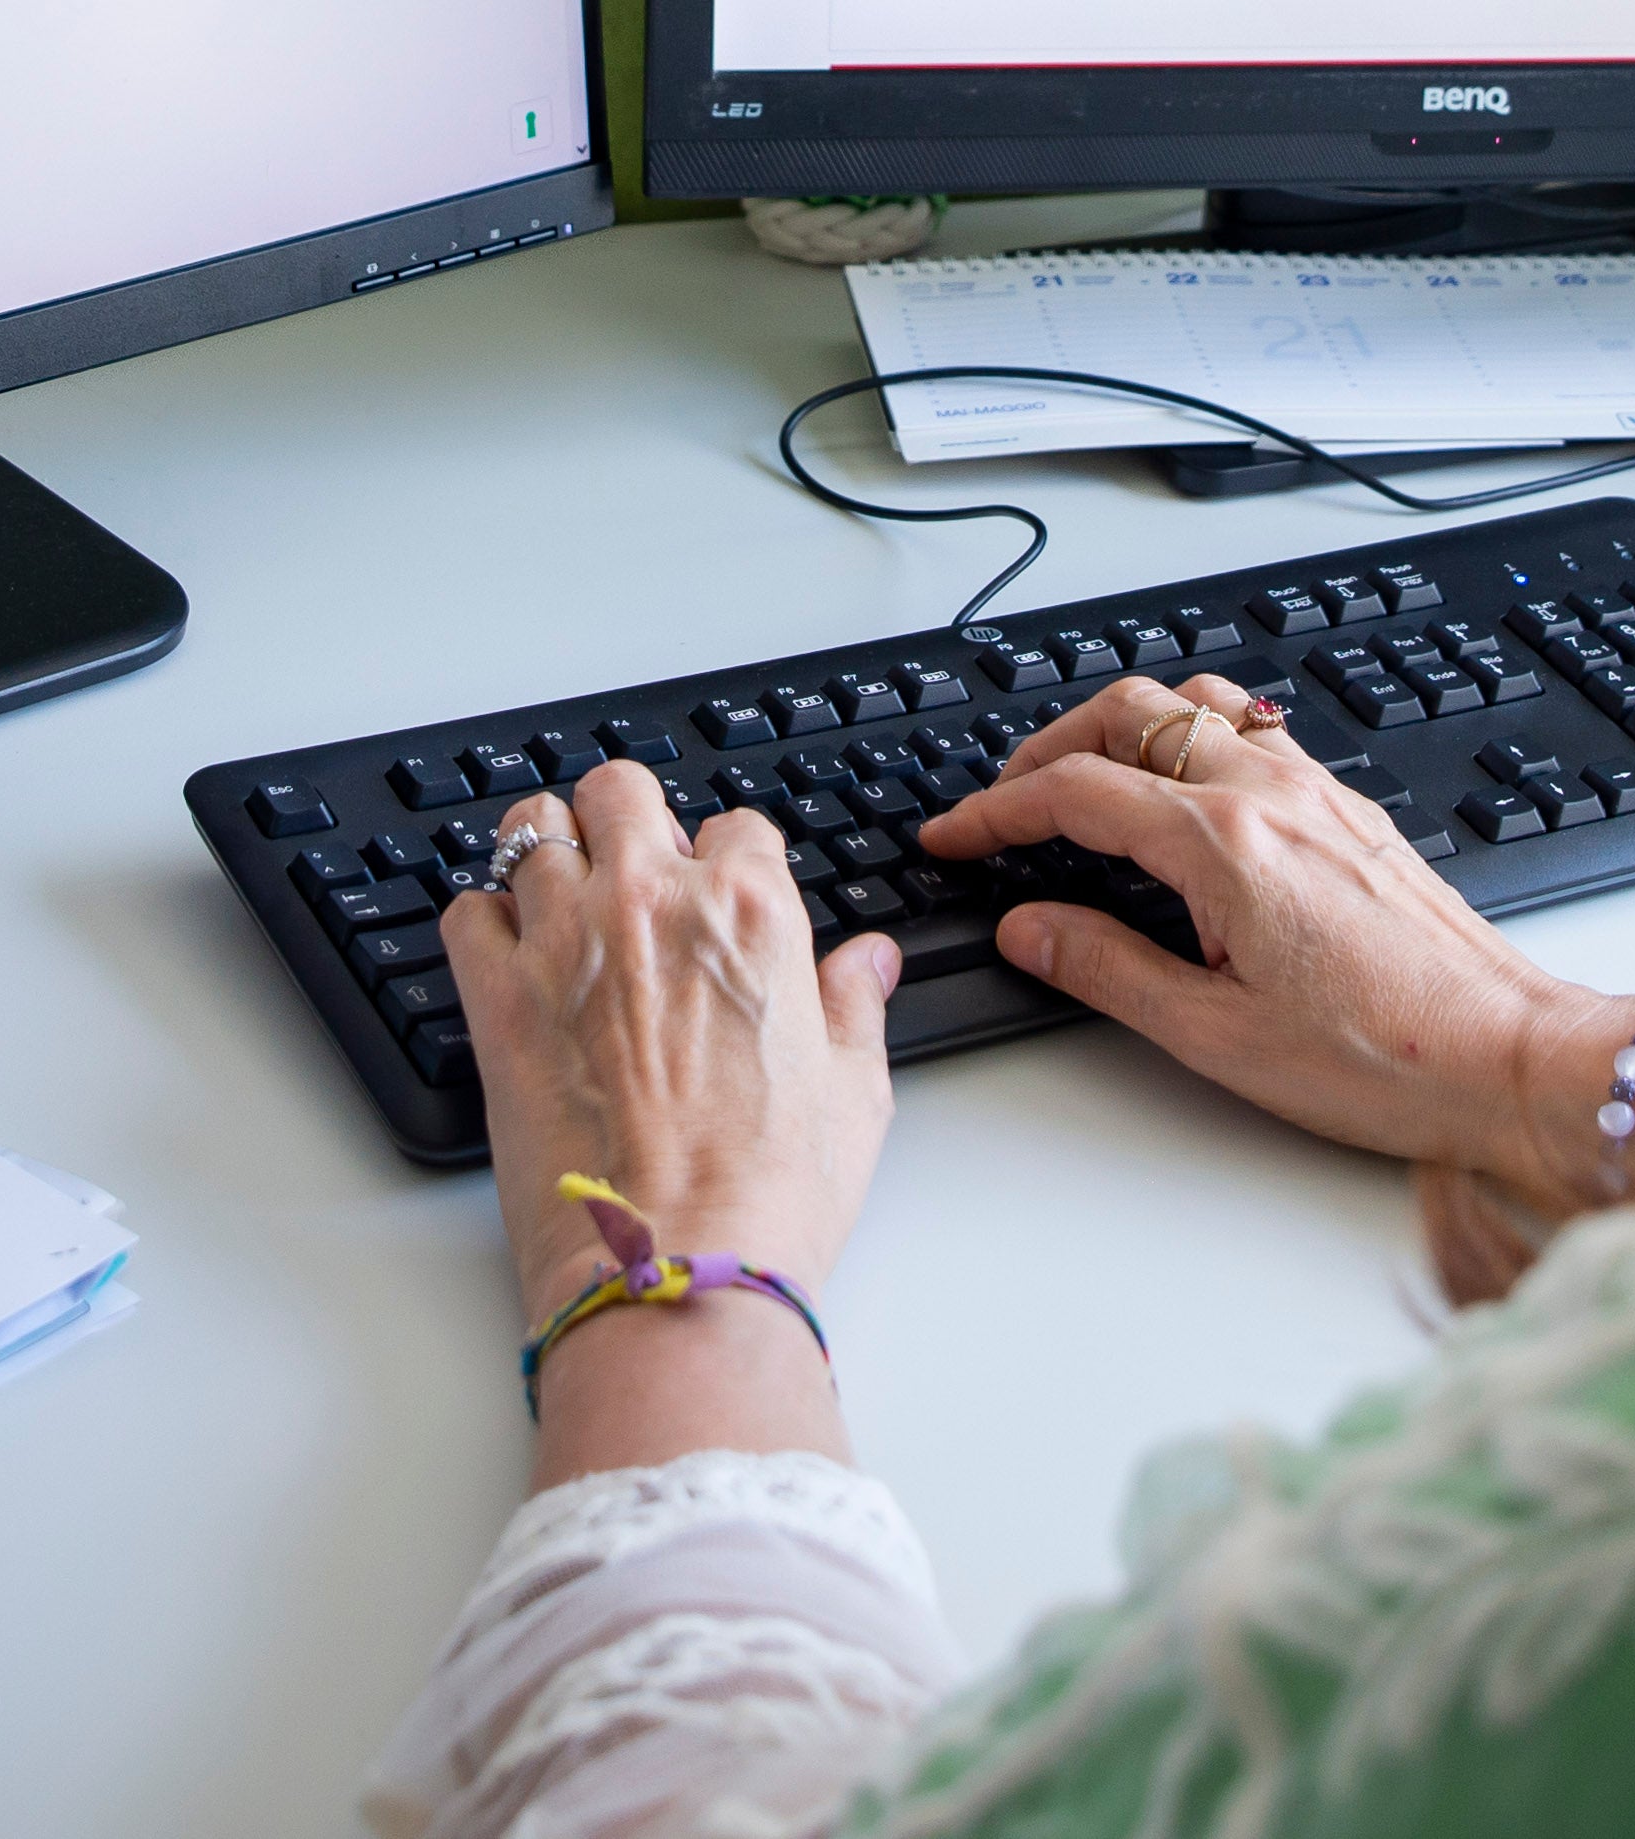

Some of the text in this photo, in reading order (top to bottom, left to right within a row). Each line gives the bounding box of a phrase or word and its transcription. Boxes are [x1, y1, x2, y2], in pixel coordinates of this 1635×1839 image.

[1422, 86, 1511, 115] BenQ
[711, 102, 764, 119] LED
[1032, 274, 1064, 288] 21
[1166, 272, 1200, 285] 22
[1296, 274, 1331, 287] 23
[1426, 275, 1459, 288] 24
[935, 400, 1047, 418] MAI-MAGGIO
